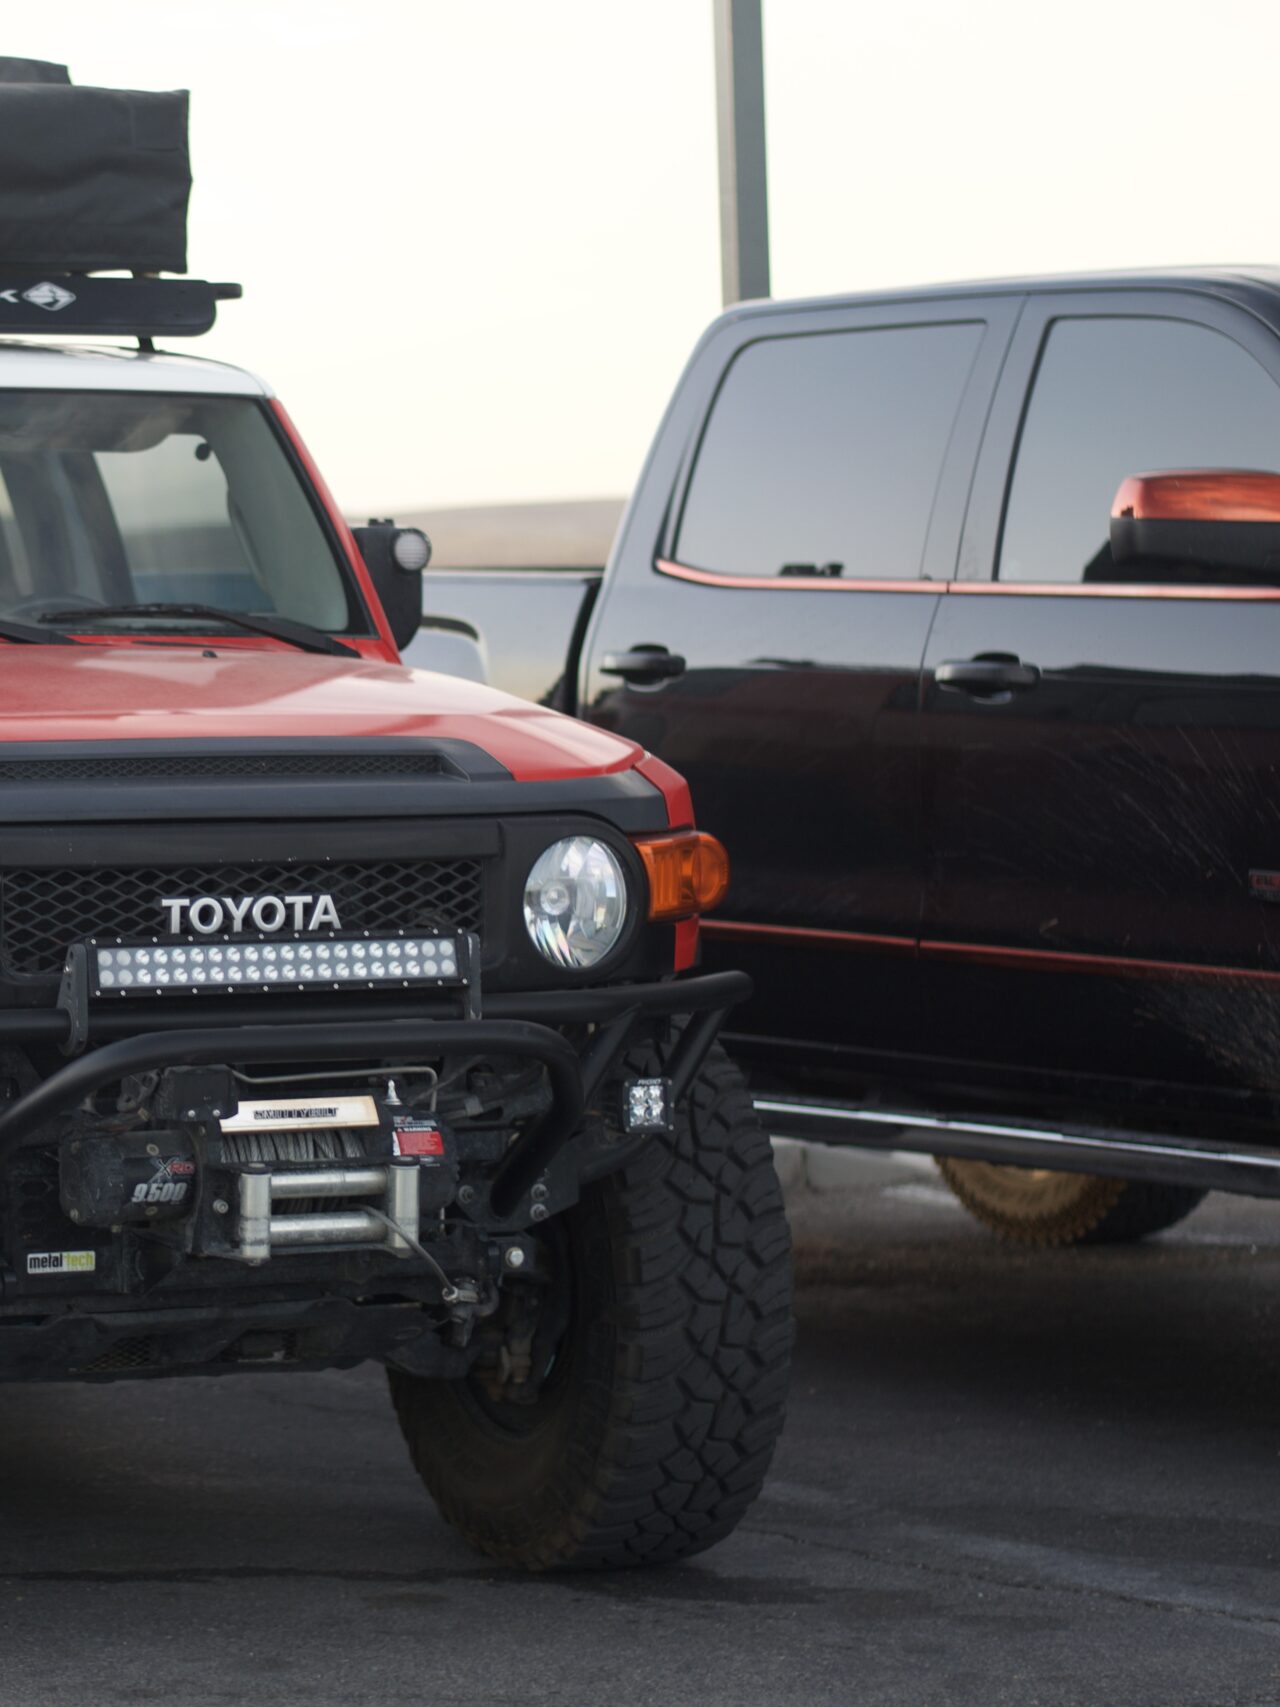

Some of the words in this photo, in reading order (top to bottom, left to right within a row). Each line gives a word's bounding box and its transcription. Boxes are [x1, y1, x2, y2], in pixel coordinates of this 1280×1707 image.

[162, 894, 342, 934] TOYOTA
[29, 1253, 63, 1268] metal
[66, 1252, 94, 1267] tech
